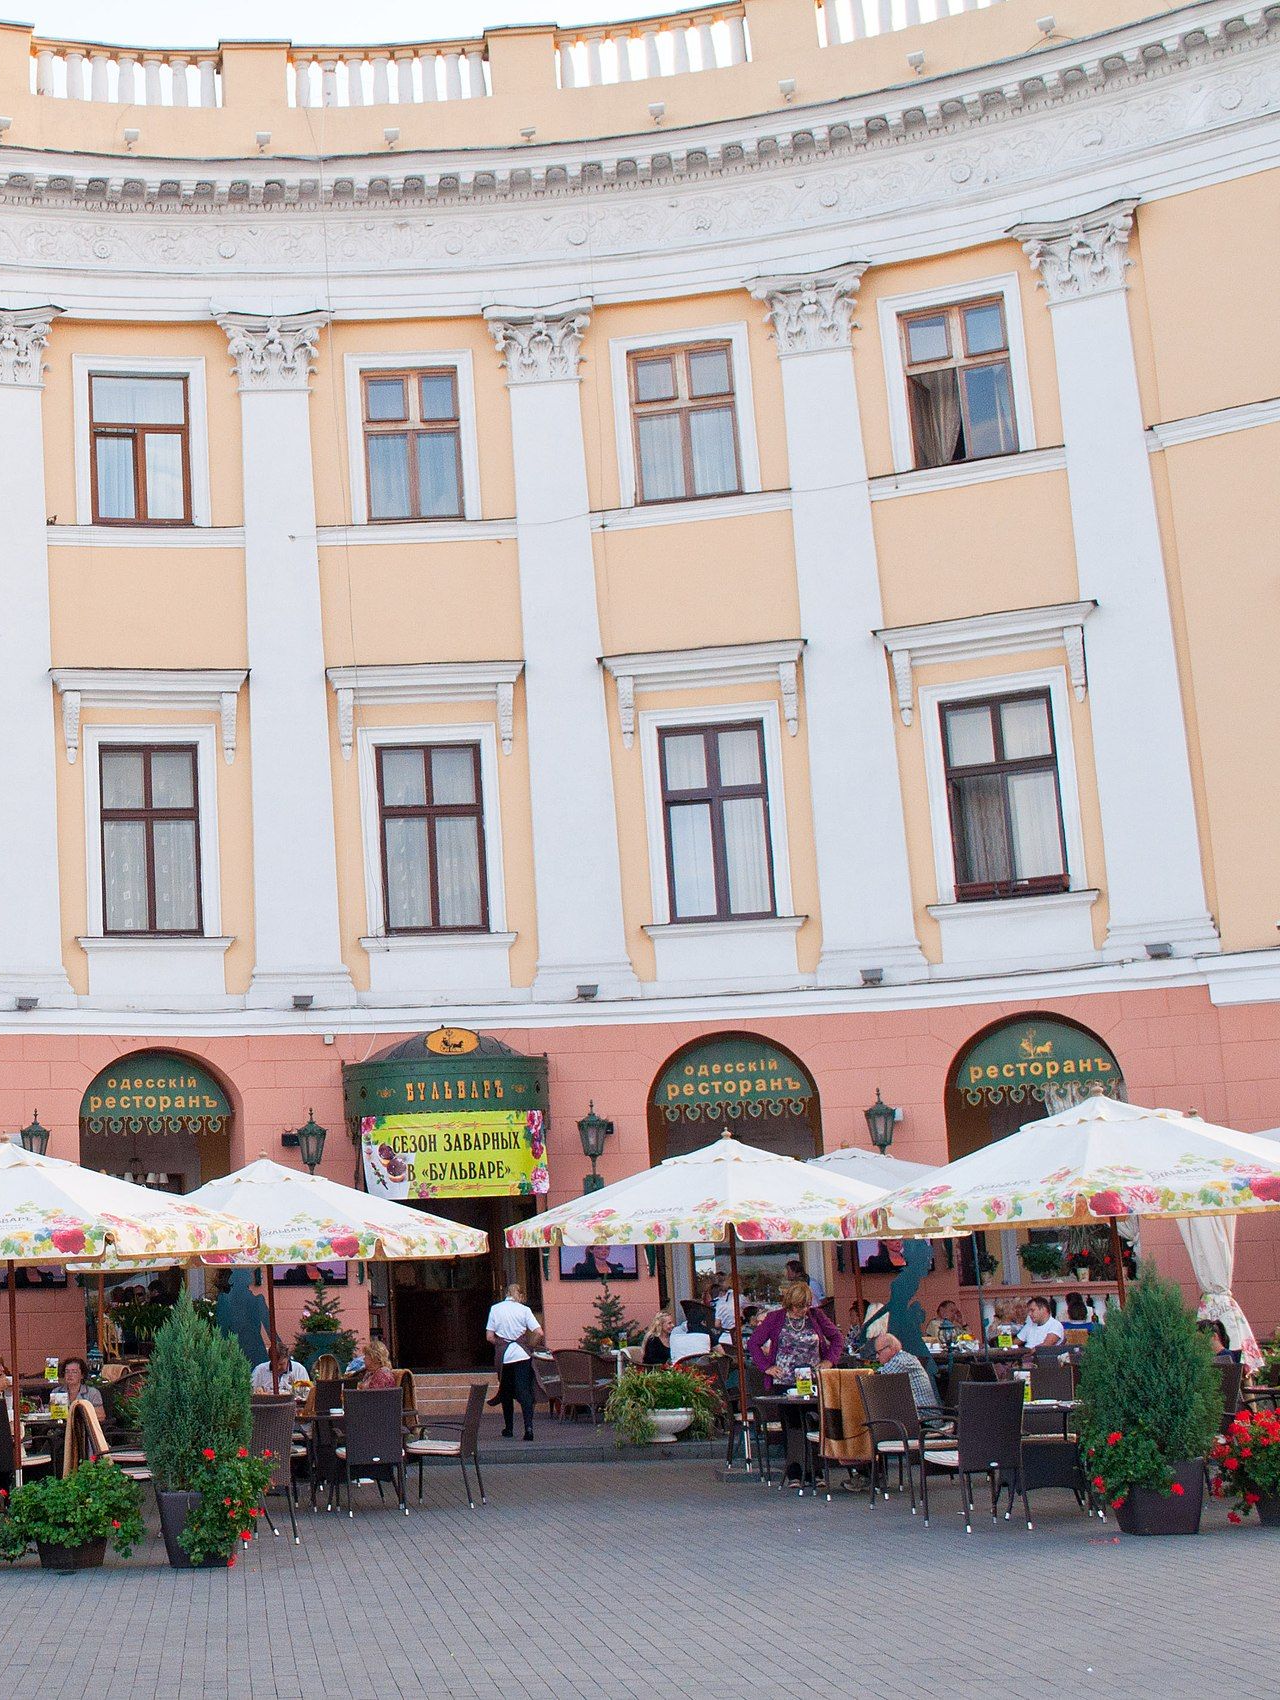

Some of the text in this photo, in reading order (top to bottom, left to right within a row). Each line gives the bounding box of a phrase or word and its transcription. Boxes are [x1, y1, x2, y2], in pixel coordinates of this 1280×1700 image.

[684, 1059, 778, 1077] одесскій
[970, 1057, 1112, 1083] ресторанъ
[107, 1076, 198, 1090] одесскій
[405, 1079, 504, 1102] БУЛЬВАРЪ
[666, 1077, 801, 1100] ресторанъ
[90, 1094, 218, 1112] ресторанъ
[392, 1131, 521, 1154] СЕЗОН ЗАВАРНЫХ
[407, 1160, 511, 1182] В «БУЛЬВАРЕ»
